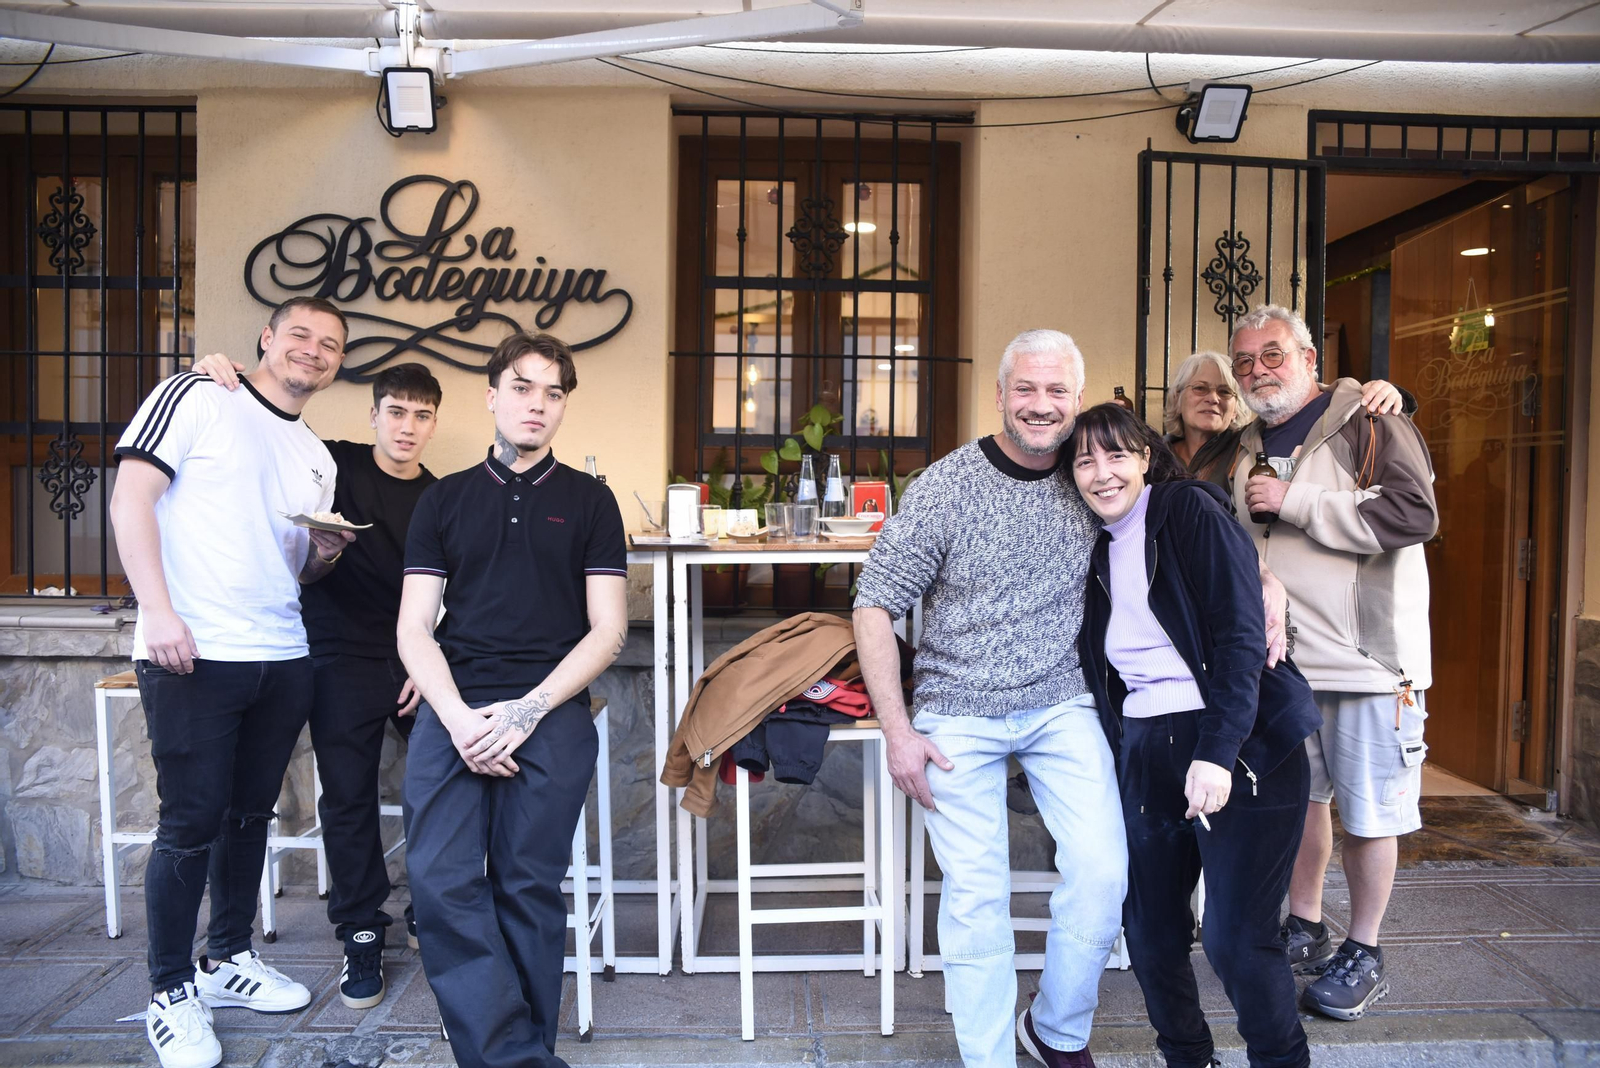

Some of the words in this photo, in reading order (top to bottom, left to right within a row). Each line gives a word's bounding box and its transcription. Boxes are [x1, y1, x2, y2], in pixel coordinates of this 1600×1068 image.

[374, 174, 517, 262] La
[244, 213, 633, 335] Bodeguiya
[1451, 329, 1496, 372] La
[1416, 358, 1536, 402] Bodeguiya
[547, 516, 565, 524] HUGO
